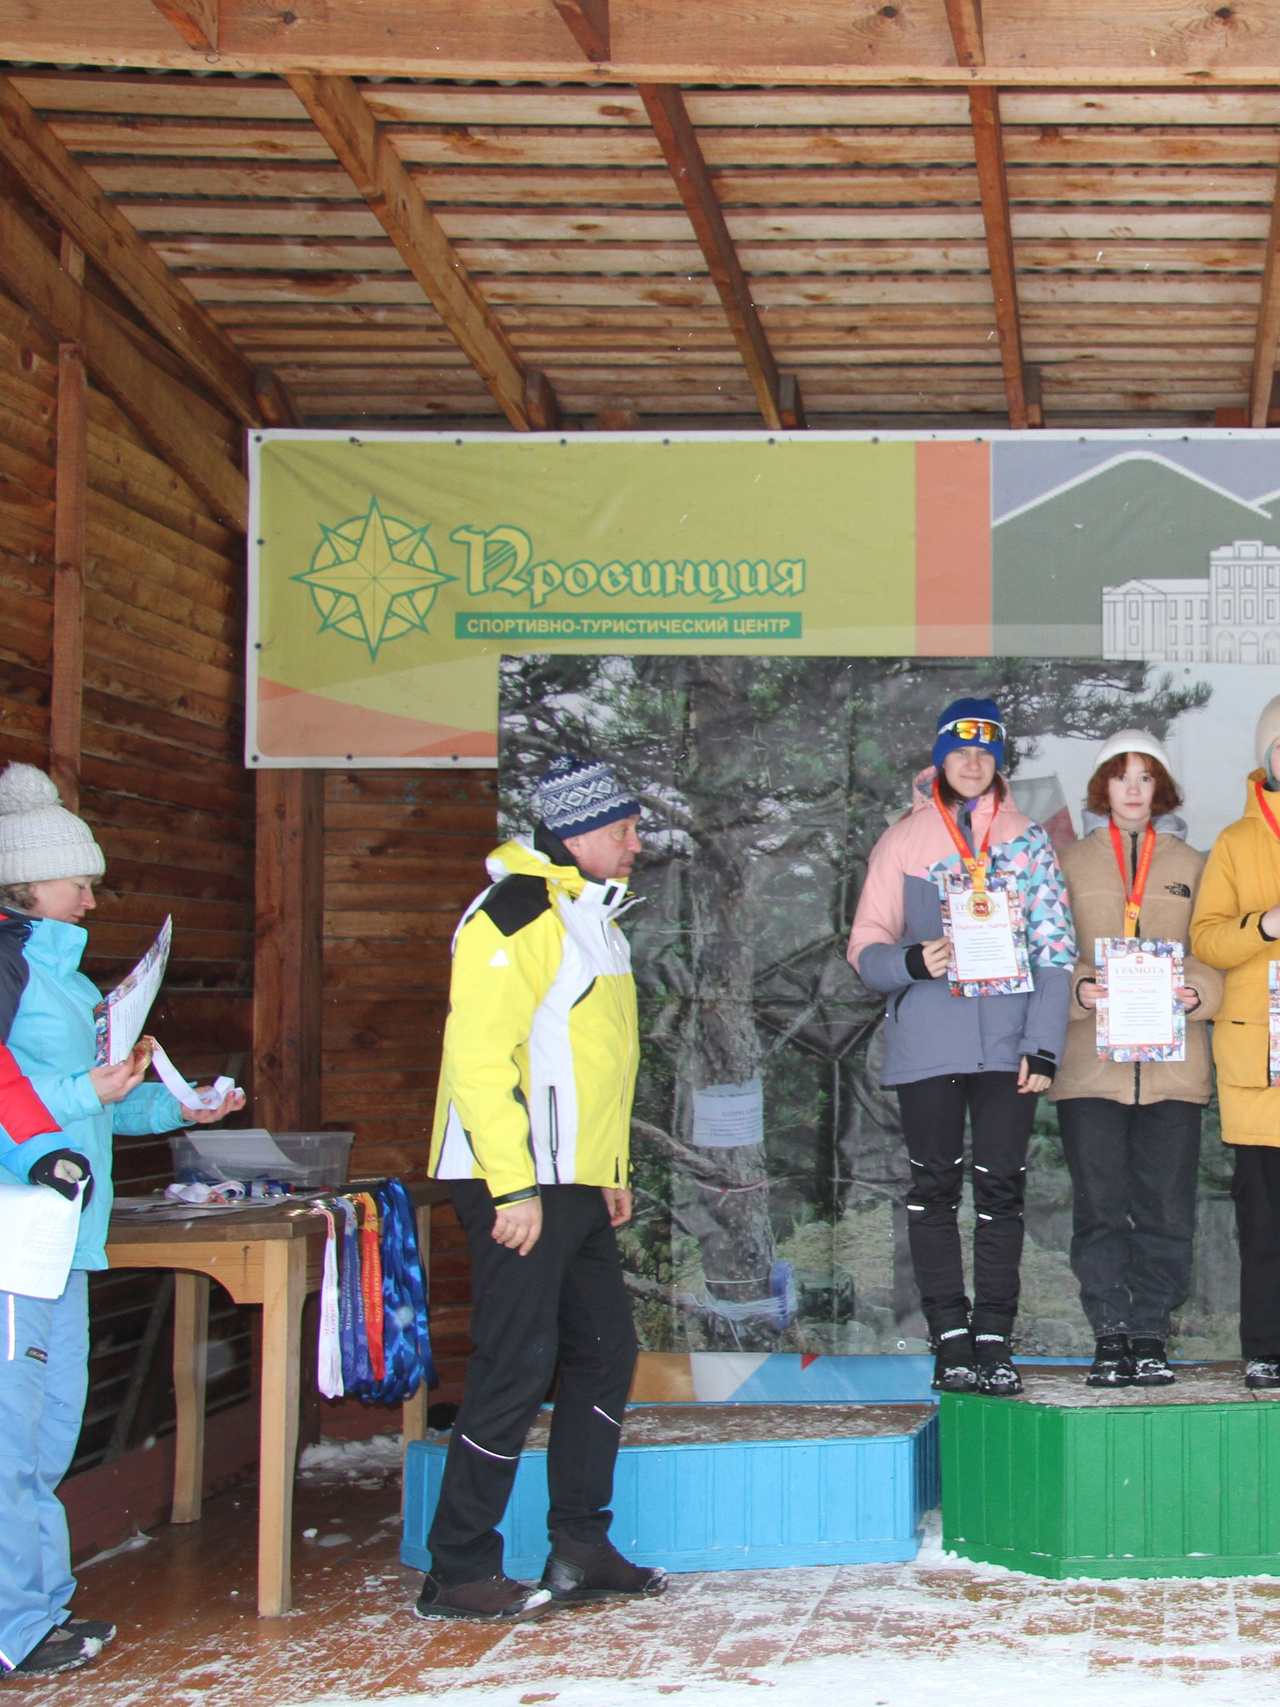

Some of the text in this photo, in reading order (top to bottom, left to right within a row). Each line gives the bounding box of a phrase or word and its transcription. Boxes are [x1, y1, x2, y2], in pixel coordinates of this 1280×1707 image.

[449, 524, 807, 608] Провинция
[466, 615, 792, 636] СПОРТИВНО-ТУРИСТИЧЕСКИЙ ЦЕНТР
